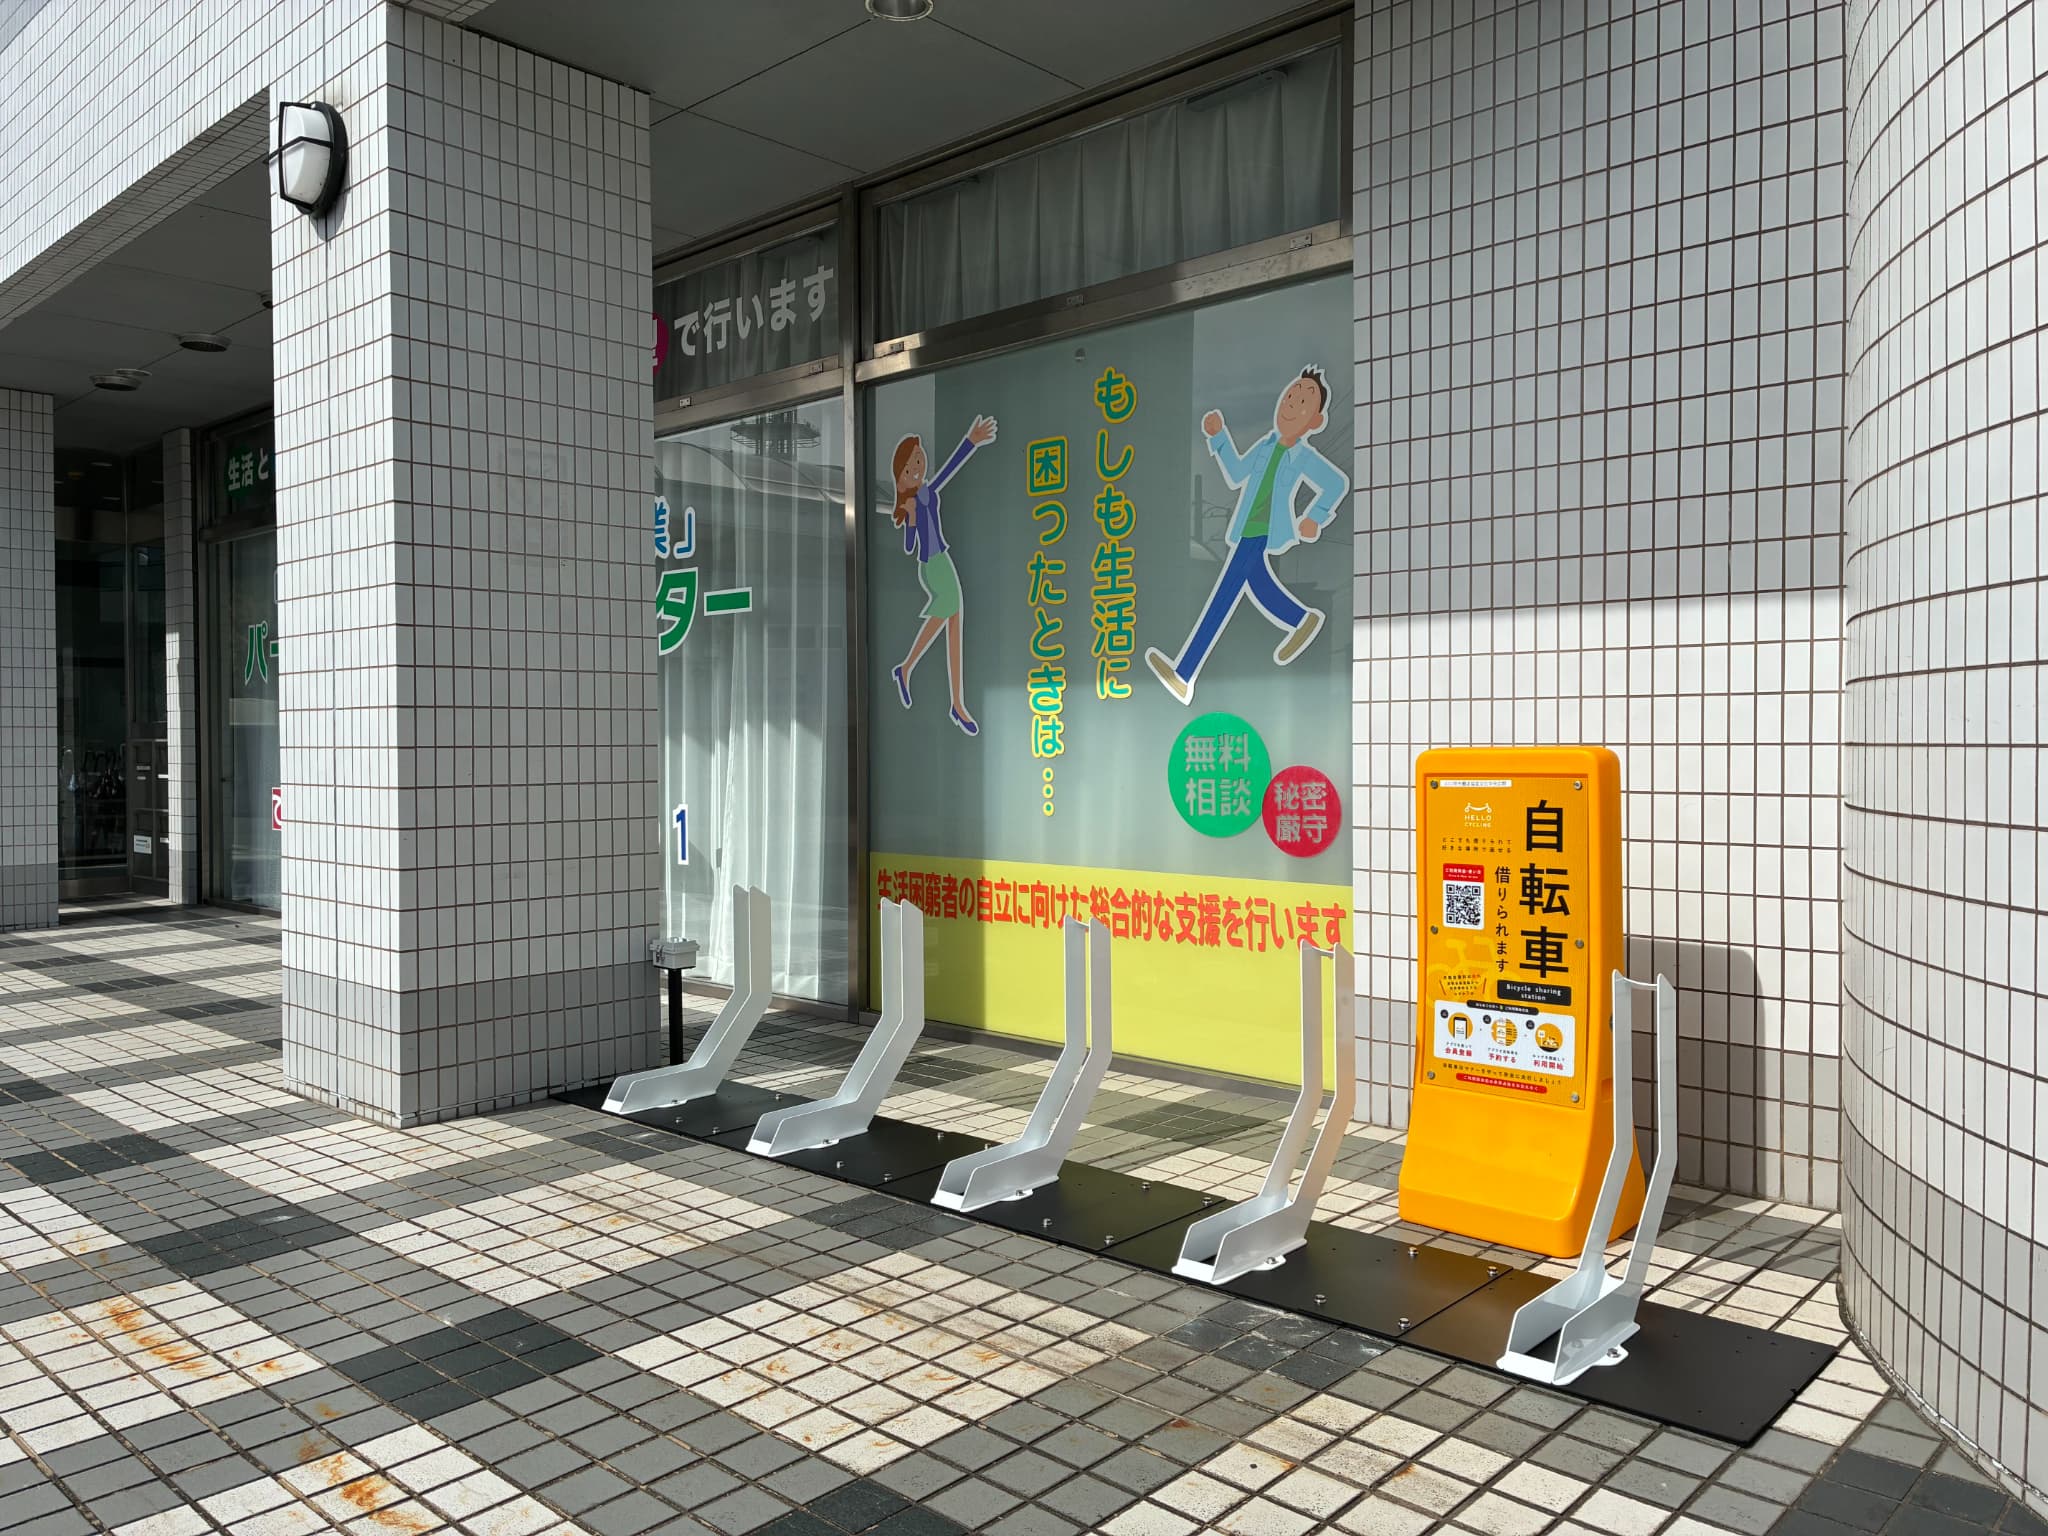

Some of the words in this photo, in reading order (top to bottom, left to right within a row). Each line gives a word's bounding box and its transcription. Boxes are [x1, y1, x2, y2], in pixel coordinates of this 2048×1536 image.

[674, 265, 834, 356] で行います
[1092, 367, 1137, 699] もしも生活に
[1184, 733, 1251, 773] 無料
[1185, 777, 1251, 816] 相談
[1274, 781, 1328, 811] 秘密
[1276, 814, 1328, 843] 厳守
[1519, 800, 1570, 979] 自転車
[1495, 866, 1511, 973] 借りられます
[1506, 983, 1531, 993] Bicycle
[1535, 985, 1562, 997] sharing
[1521, 992, 1546, 1001] station
